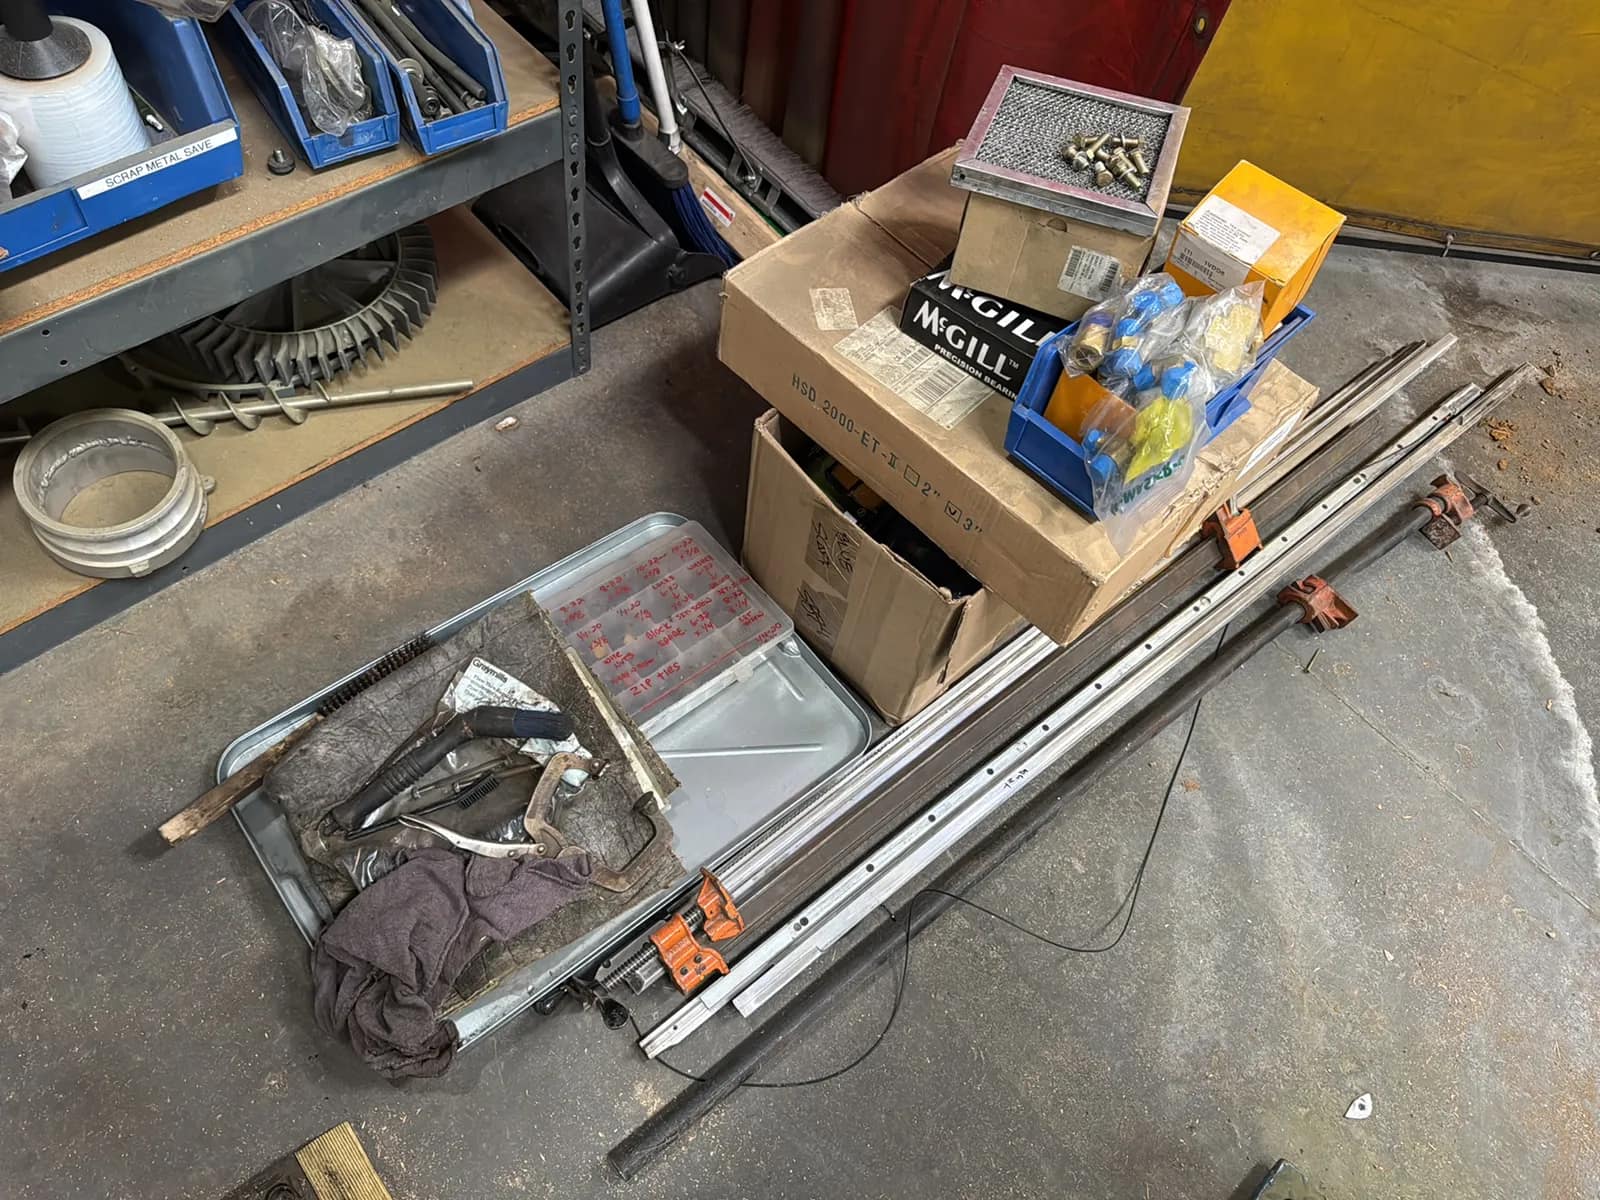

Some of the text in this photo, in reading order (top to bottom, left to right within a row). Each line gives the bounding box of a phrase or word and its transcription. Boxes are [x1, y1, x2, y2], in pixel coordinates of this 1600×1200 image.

[105, 139, 213, 188] SCRAP METAL SAVE
[934, 343, 983, 379] PRECISION
[792, 373, 817, 402] HSD
[472, 658, 508, 684] Graymills
